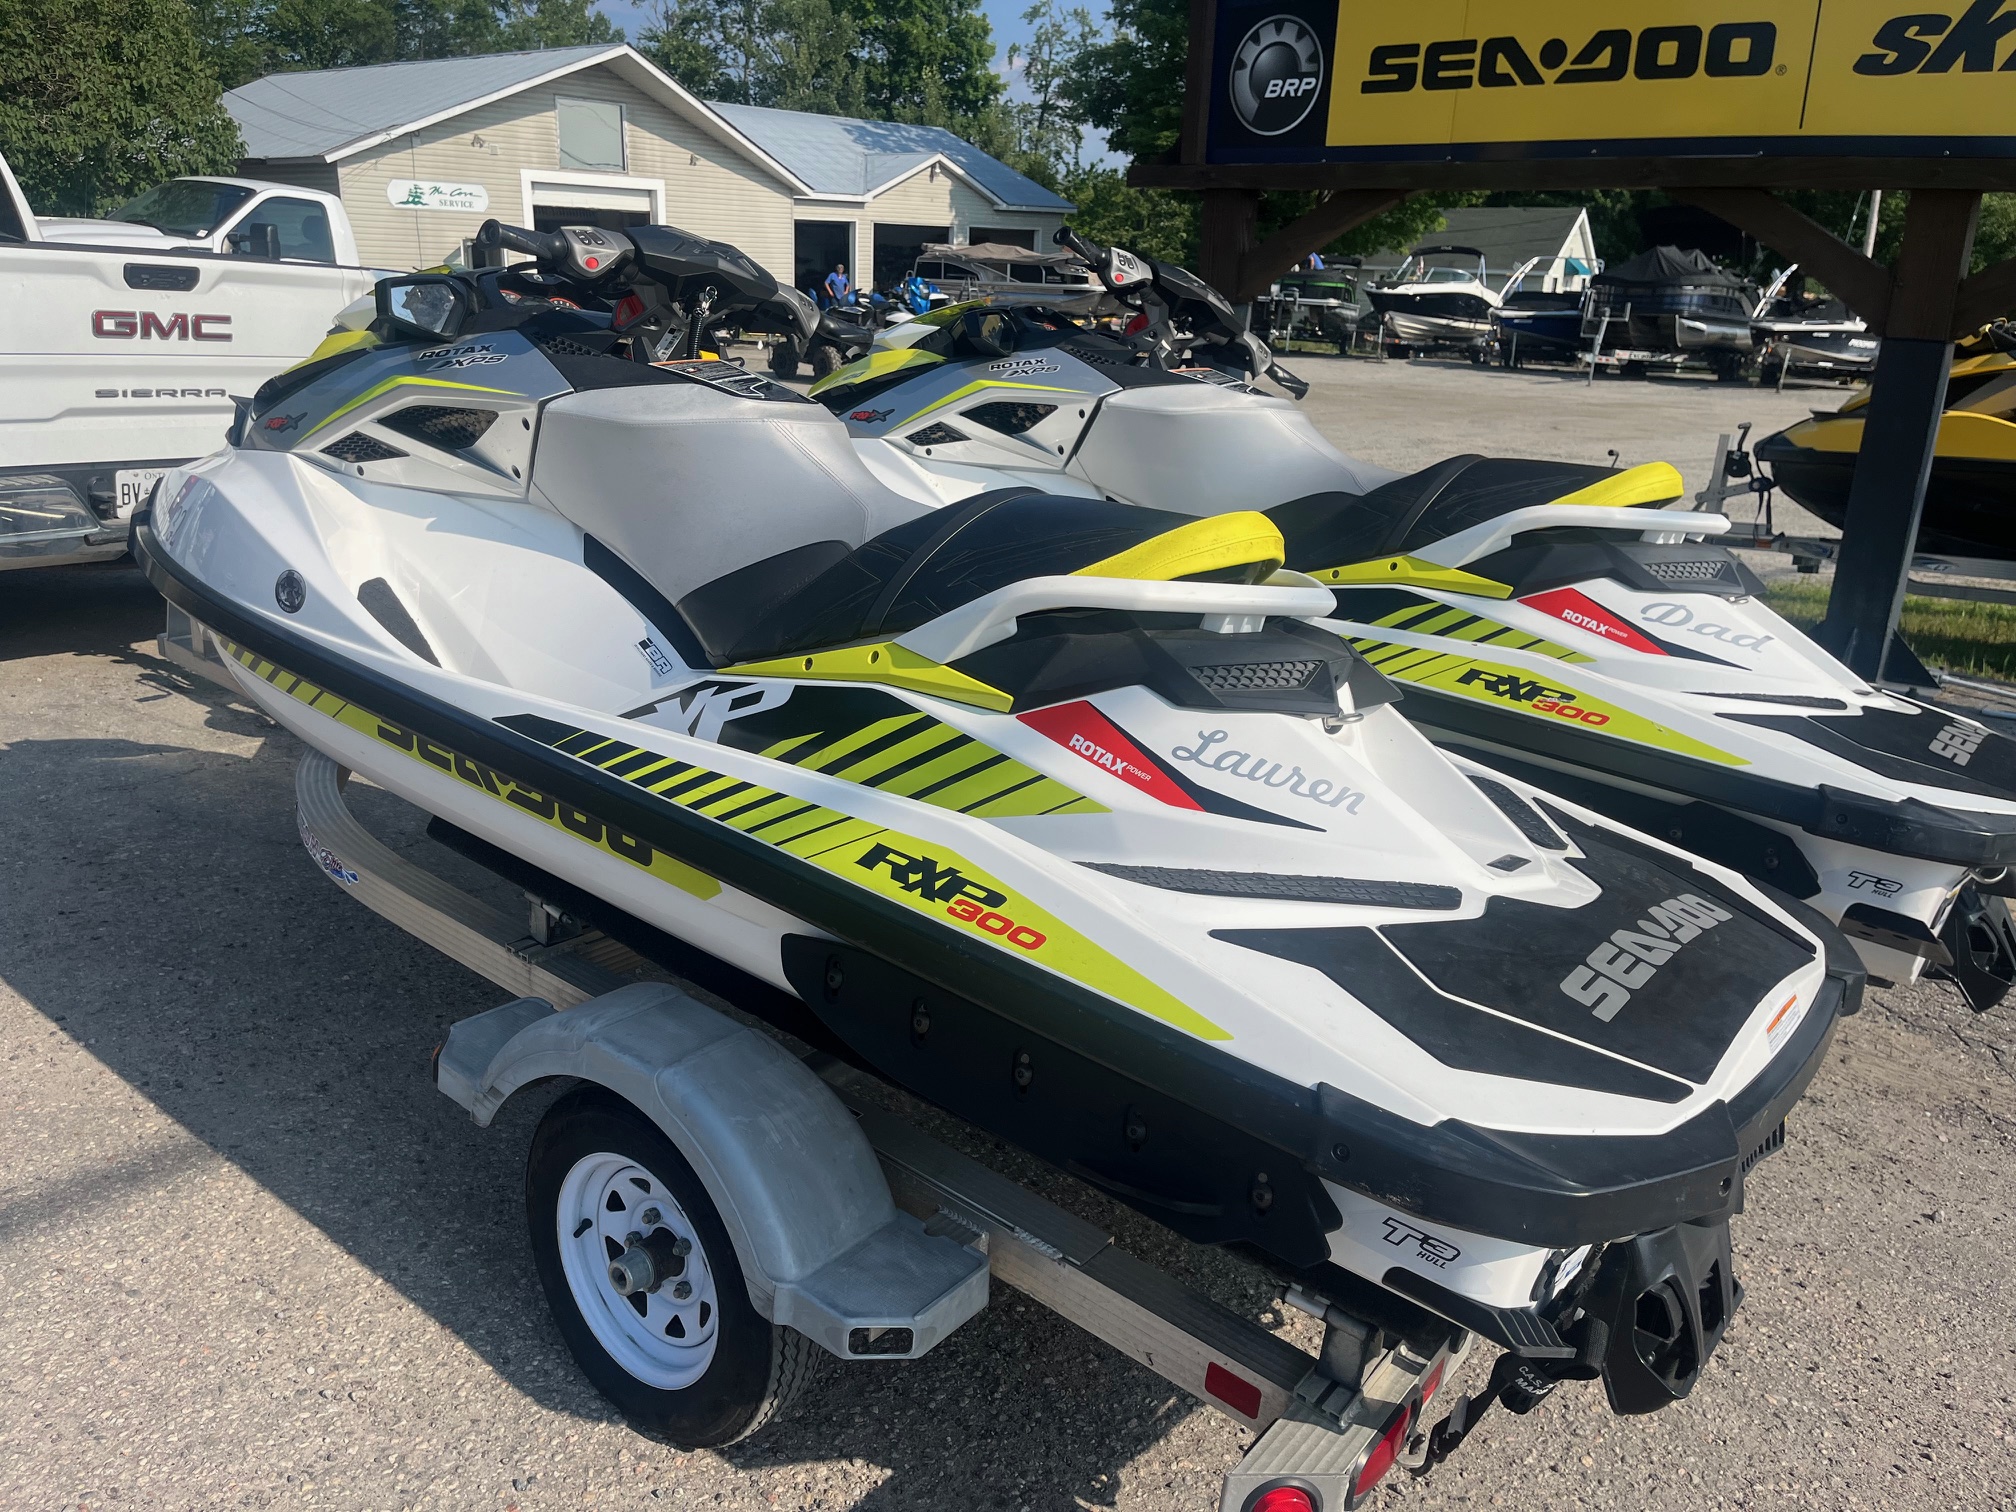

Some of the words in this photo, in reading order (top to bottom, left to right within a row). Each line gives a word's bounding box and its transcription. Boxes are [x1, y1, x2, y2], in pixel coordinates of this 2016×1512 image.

[1264, 77, 1317, 98] BRP
[438, 199, 474, 208] SERVICE
[449, 187, 482, 198] Cove
[91, 309, 233, 342] GMC
[419, 344, 494, 360] ROTAX
[990, 358, 1045, 371] ROTAX
[95, 388, 227, 399] SIERRA
[1561, 608, 1609, 635] ROTAX
[1608, 626, 1628, 638] POWER
[1640, 602, 1775, 654] Dad
[1453, 667, 1577, 703] RXP
[1531, 698, 1610, 726] 300
[1068, 733, 1128, 775] ROTAX
[1125, 764, 1152, 782] POWER
[1171, 729, 1366, 816] Lauren
[853, 841, 1008, 908] RXP
[1848, 870, 1904, 893] T3
[946, 898, 1047, 950] 300
[1382, 1216, 1462, 1262] T3
[1416, 1250, 1446, 1270] HULL
